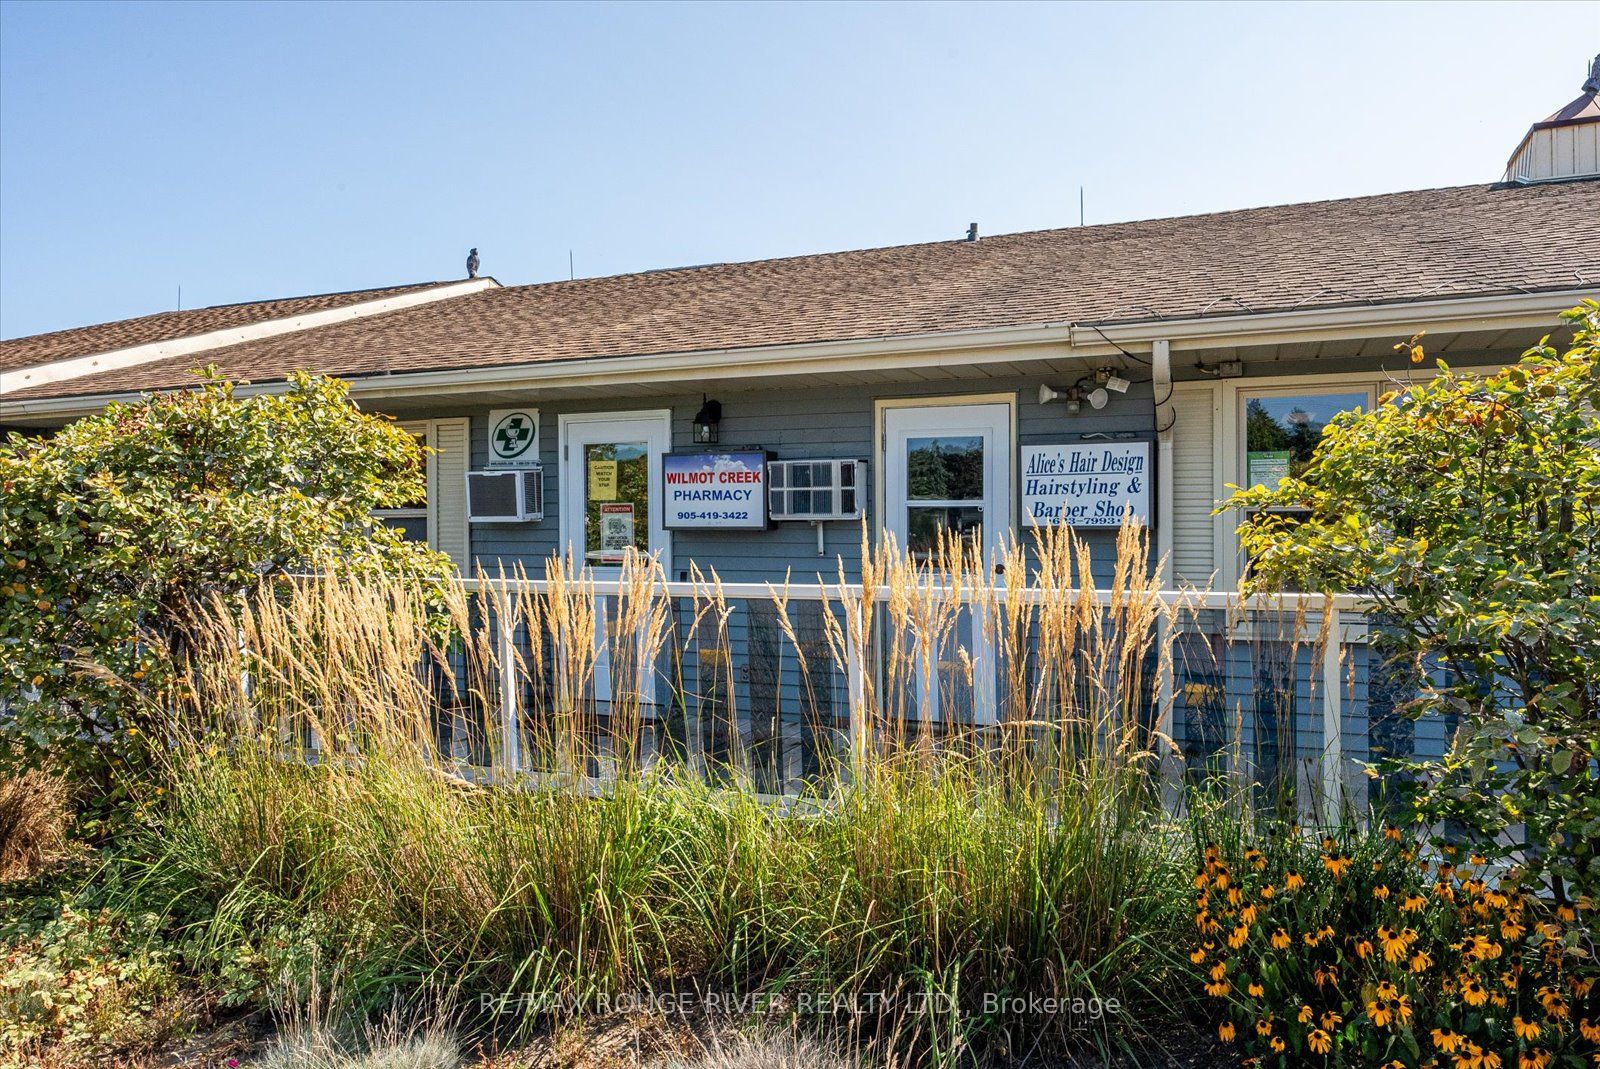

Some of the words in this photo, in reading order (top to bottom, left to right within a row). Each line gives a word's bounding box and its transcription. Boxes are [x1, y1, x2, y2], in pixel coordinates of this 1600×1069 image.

[1026, 452, 1066, 474] Alice's
[1068, 451, 1098, 472] Hair
[1100, 449, 1144, 475] Design
[666, 472, 715, 484] WILMOT
[719, 471, 762, 483] CREEK
[1025, 477, 1121, 497] Hairstyling
[1127, 476, 1142, 494] &
[673, 489, 752, 501] PHARMACY
[677, 511, 749, 520] 905-419-3422
[1052, 517, 1116, 525] 63-7993
